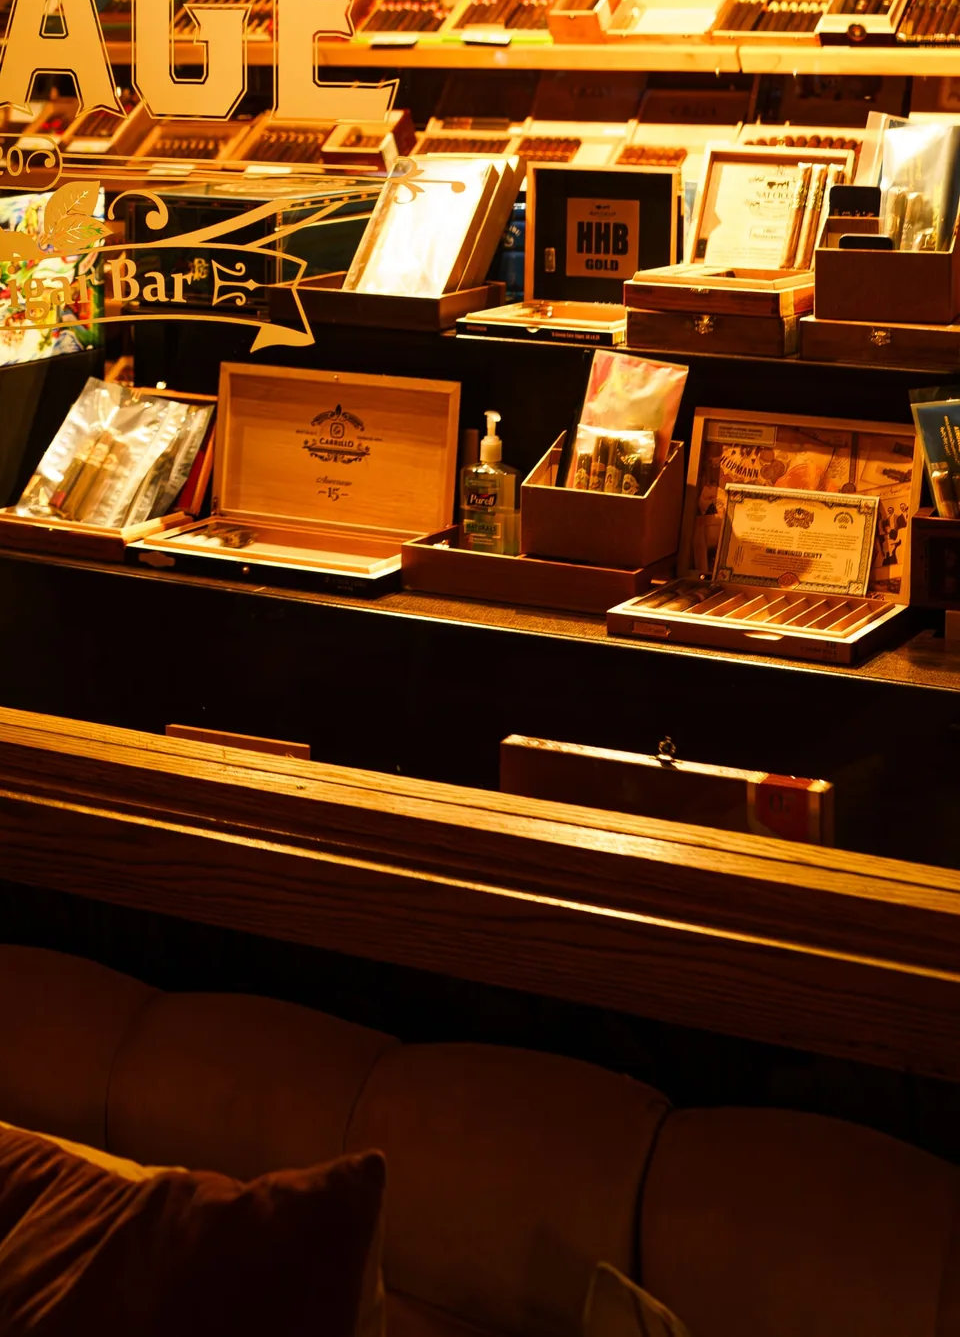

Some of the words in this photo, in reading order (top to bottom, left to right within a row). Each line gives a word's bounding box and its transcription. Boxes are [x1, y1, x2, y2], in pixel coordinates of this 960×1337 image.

[577, 221, 629, 256] HHB
[107, 257, 194, 303] Bar
[585, 258, 619, 271] GOLD
